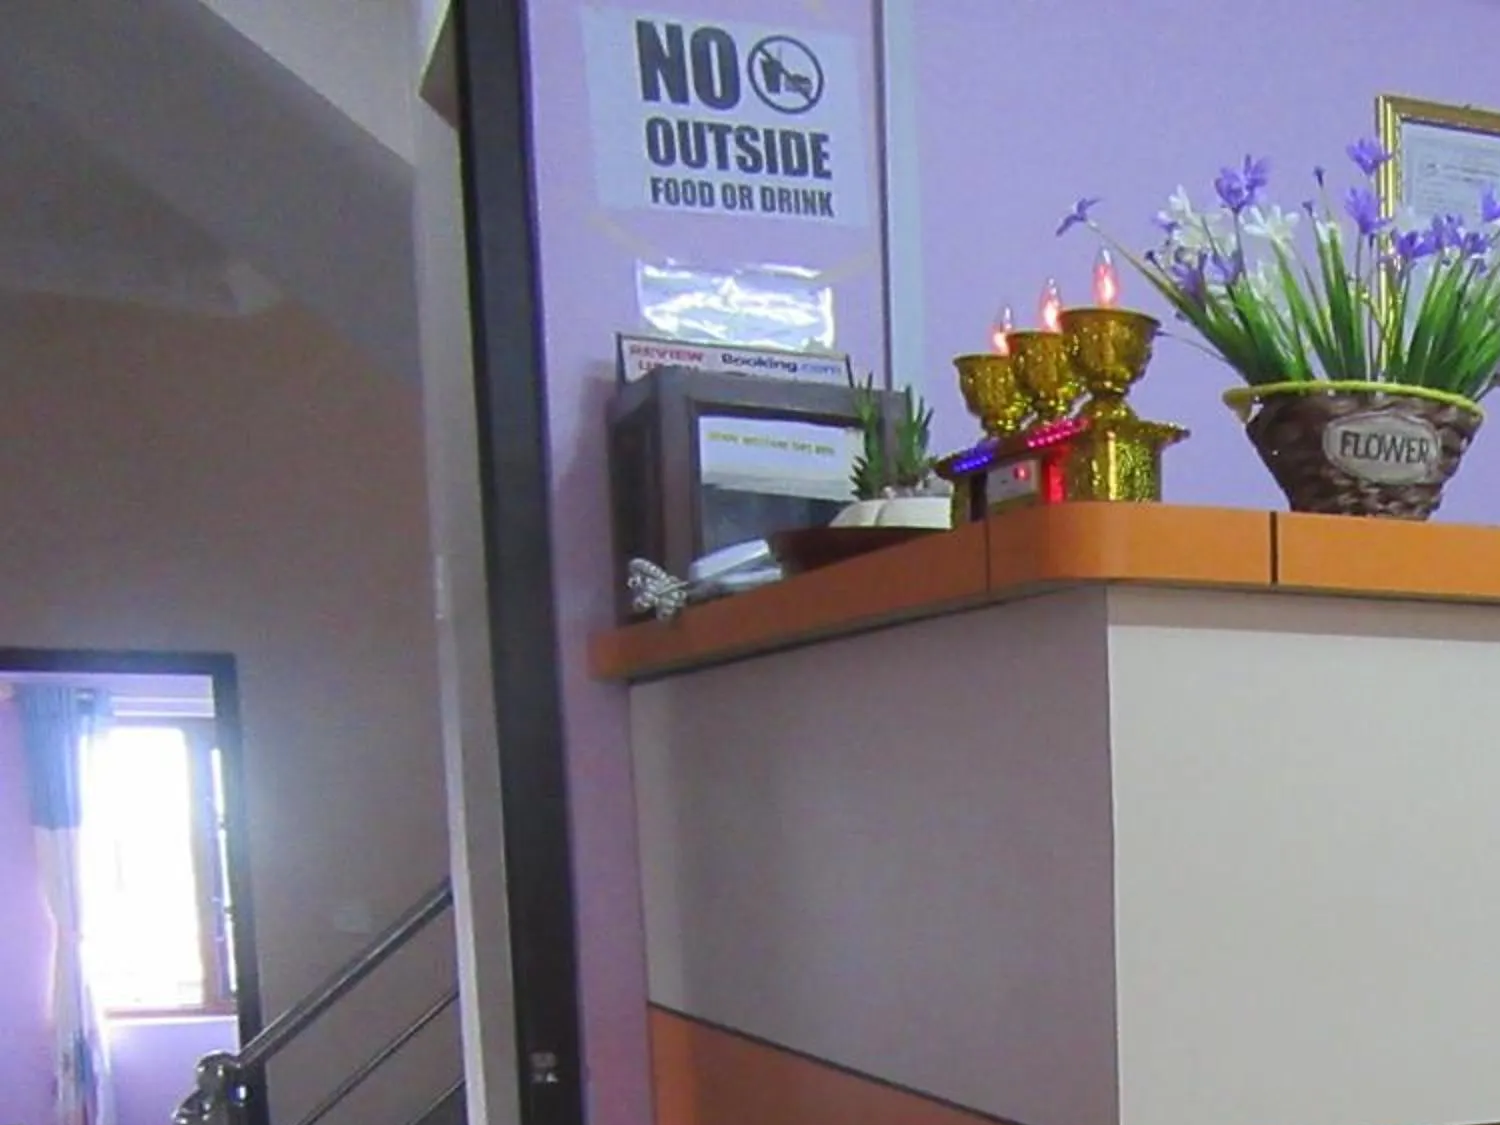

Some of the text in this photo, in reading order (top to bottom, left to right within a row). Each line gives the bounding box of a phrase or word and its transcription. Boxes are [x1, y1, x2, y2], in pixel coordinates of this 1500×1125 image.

[636, 19, 741, 111] NO
[645, 116, 833, 181] OUTSIDE
[650, 176, 835, 218] FOOD OR DRINK
[629, 344, 705, 363] REVIEW
[721, 352, 843, 374] Booking.com
[1341, 430, 1429, 464] FLOWER
